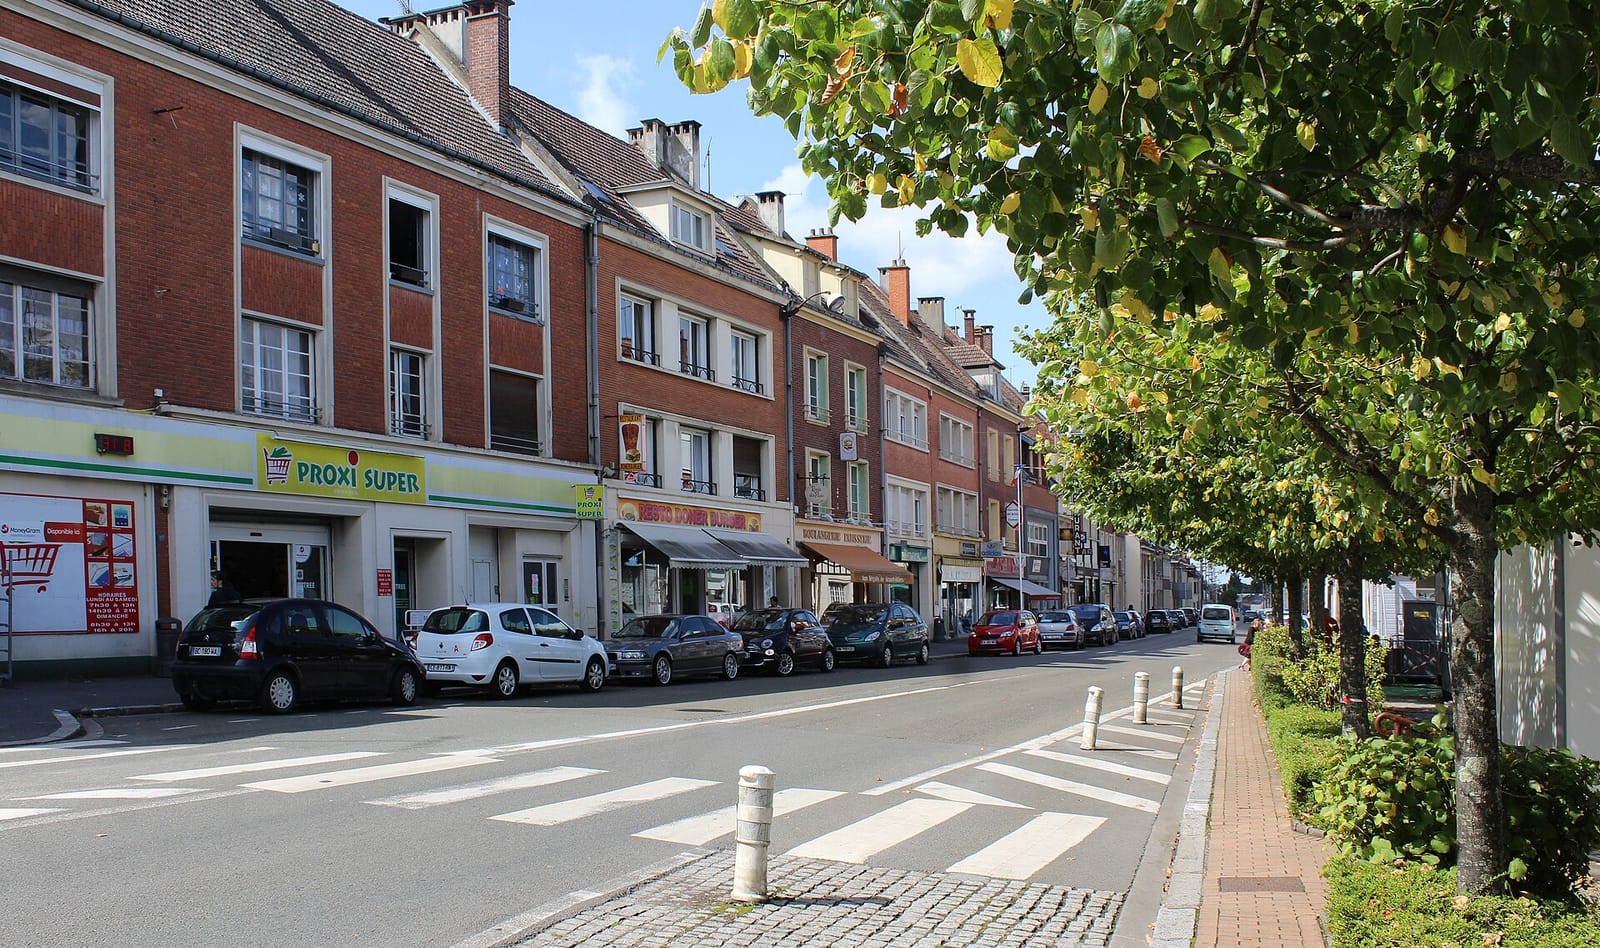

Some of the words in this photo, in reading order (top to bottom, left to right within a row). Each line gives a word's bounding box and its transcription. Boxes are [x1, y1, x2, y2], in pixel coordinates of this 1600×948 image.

[297, 450, 359, 488] PROXI
[364, 468, 420, 493] SUPER
[577, 497, 602, 508] PROXI
[639, 503, 673, 521] RESTO
[675, 507, 709, 526] DONER
[710, 511, 746, 530] BURGER
[10, 526, 41, 535] MoneyGram
[47, 527, 73, 536] Disponible
